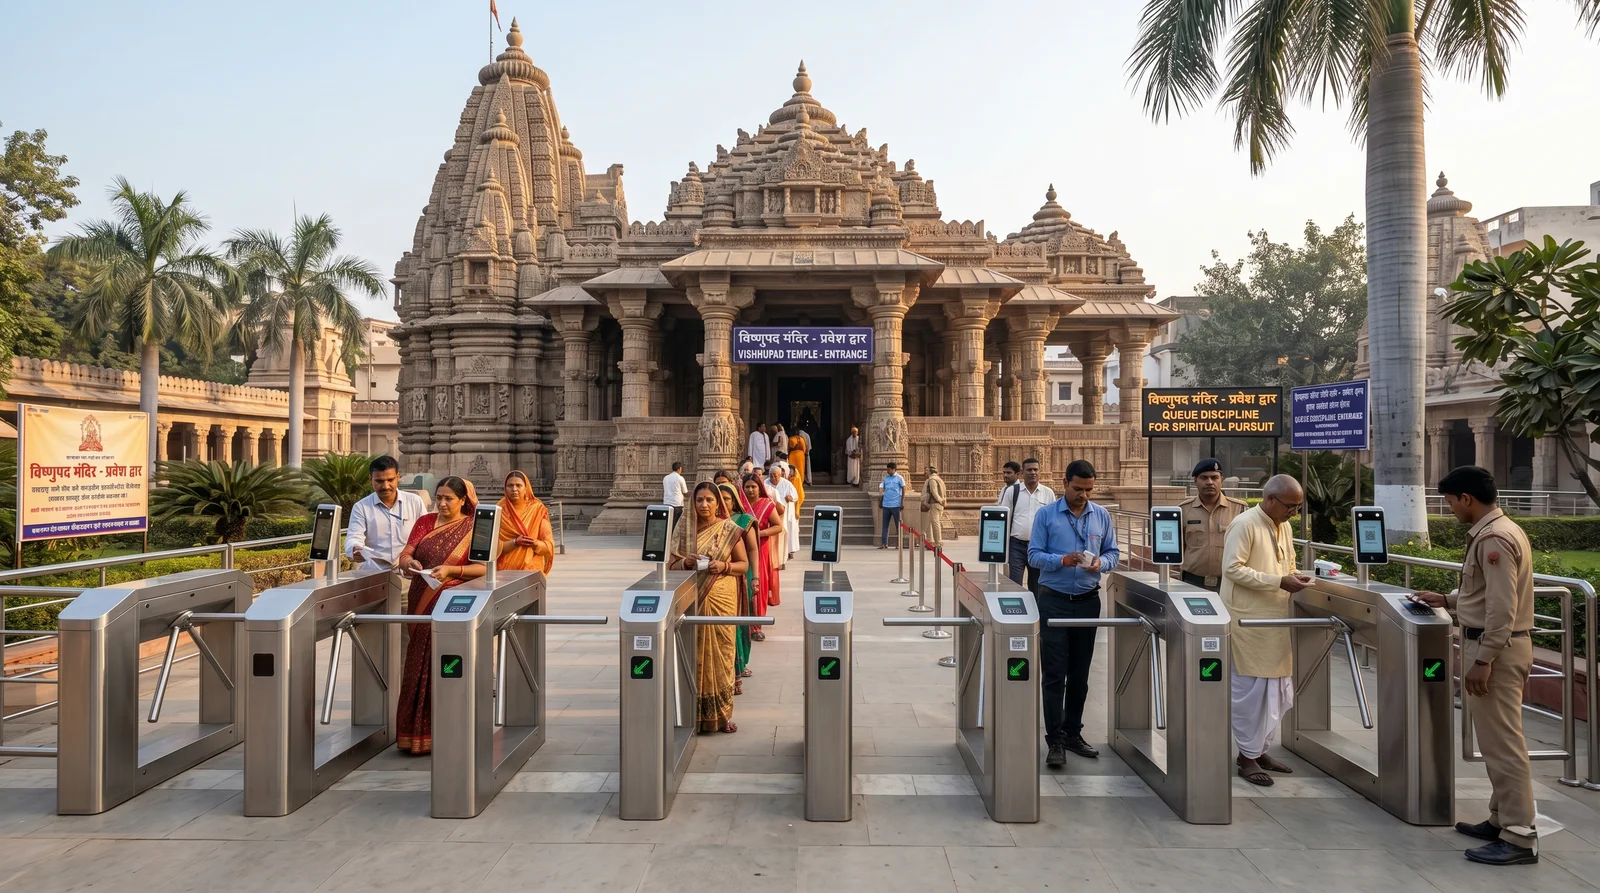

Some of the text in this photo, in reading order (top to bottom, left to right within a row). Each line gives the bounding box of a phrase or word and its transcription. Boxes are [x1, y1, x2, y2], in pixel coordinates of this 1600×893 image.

[738, 330, 780, 347] विष्णुपद
[783, 330, 809, 344] मंदिर
[820, 330, 846, 344] प्रवेश
[848, 333, 867, 345] द्वार
[786, 349, 818, 359] TEMPLE
[824, 349, 868, 359] ENTRANCE
[1148, 392, 1189, 409] विष्णुपद
[1191, 391, 1218, 404] मंदिर
[1228, 391, 1255, 404] प्रवेश
[1258, 394, 1277, 406] द्वार
[1162, 410, 1259, 420] QUEUE DISCIPLINE
[1148, 422, 1275, 431] FOR SPIRITUAL PURSUIT
[30, 463, 71, 482] विष्णुपद
[73, 463, 97, 478] मंदिर
[105, 462, 127, 477] प्रवेश
[129, 465, 142, 477] द्वार
